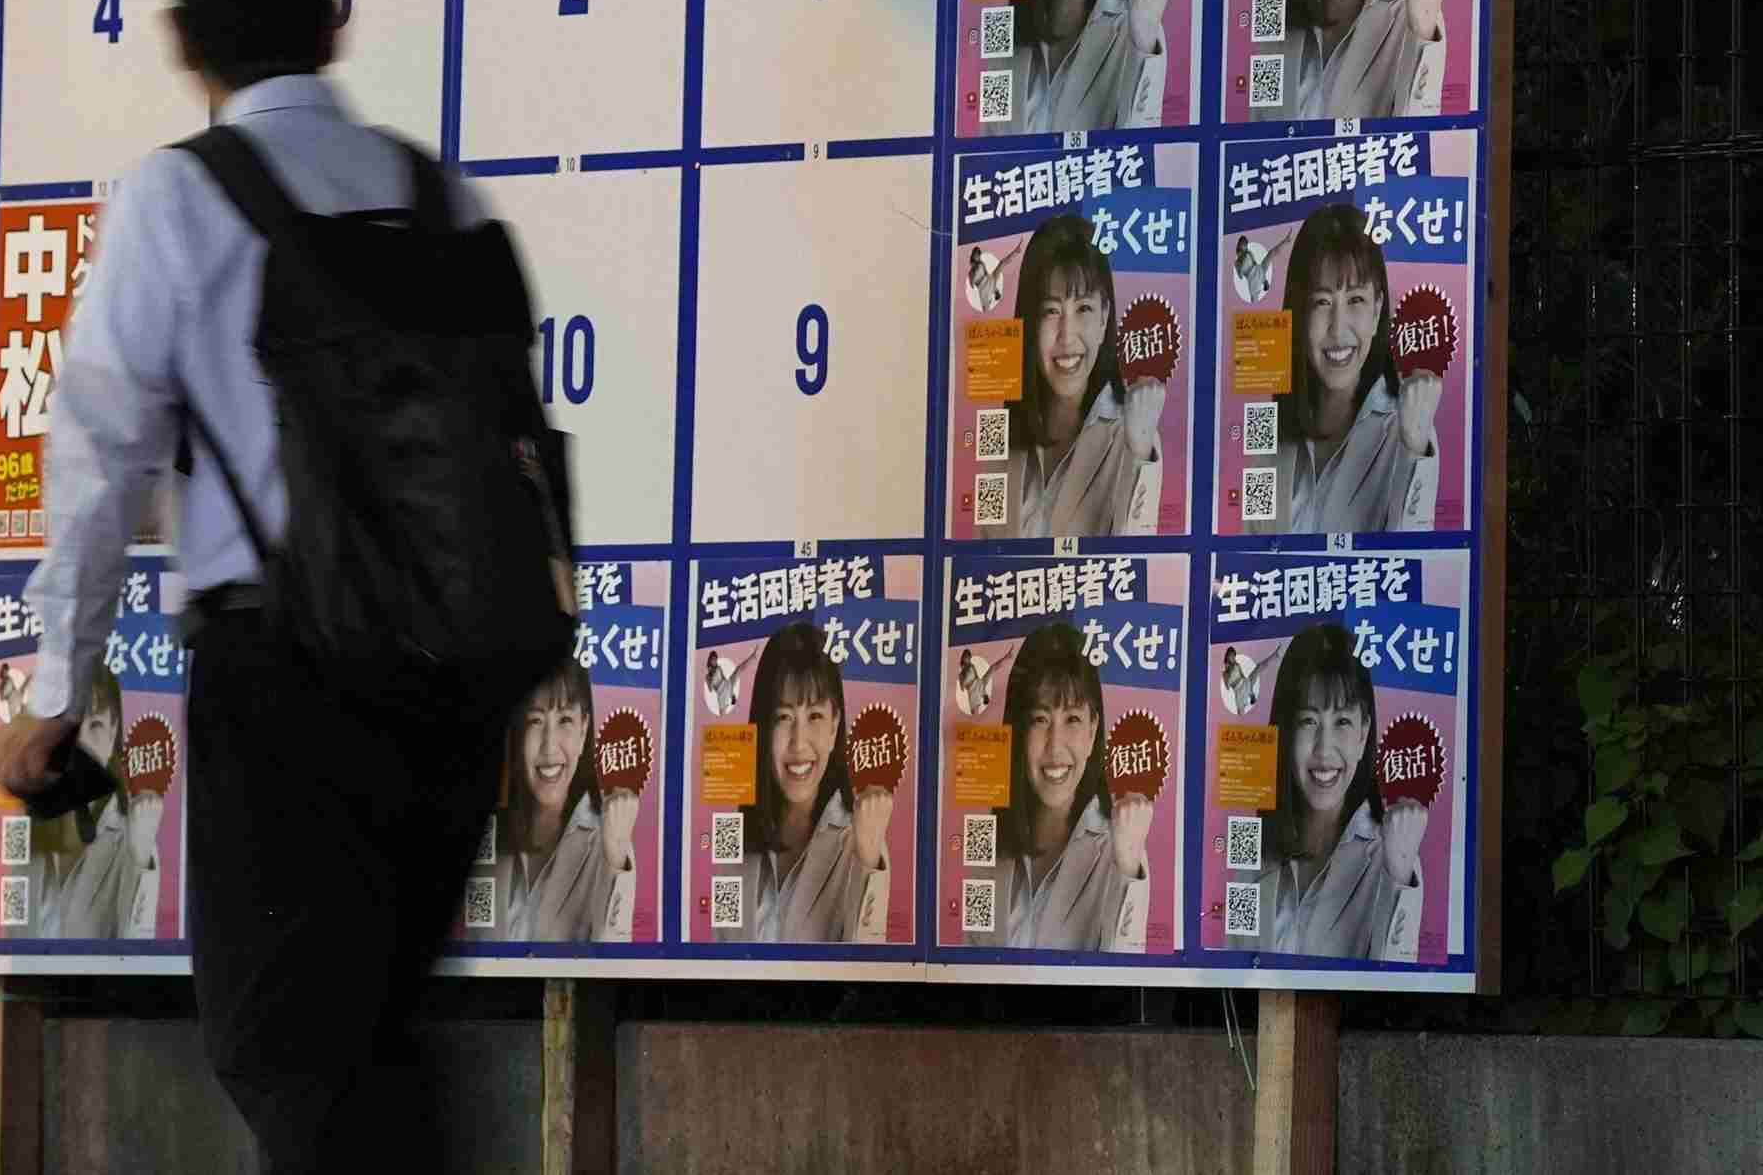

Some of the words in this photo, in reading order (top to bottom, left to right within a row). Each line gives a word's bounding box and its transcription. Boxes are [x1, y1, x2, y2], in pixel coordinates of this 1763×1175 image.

[963, 145, 1144, 225] 生活困窮者を
[1228, 132, 1420, 213] 生活困窮者を
[1091, 207, 1185, 255] なくせ!
[1363, 196, 1463, 246] なくせ!
[537, 314, 596, 405] 10
[794, 303, 830, 396] 9
[1122, 324, 1174, 366] 復活!
[1396, 314, 1452, 356] 復活!
[701, 555, 875, 629] 生活困窮者を
[954, 557, 1136, 625] 生活困窮者を
[1217, 557, 1411, 623] 生活困窮者を
[572, 622, 660, 670] なくせ!
[822, 617, 914, 666] なくせ!
[1081, 618, 1178, 670] なくせ!
[1352, 618, 1453, 674] なくせ!
[599, 737, 648, 775] 復活!
[851, 734, 902, 773] 復活!
[1110, 736, 1162, 778] 復活!
[1382, 743, 1438, 784] 復活!
